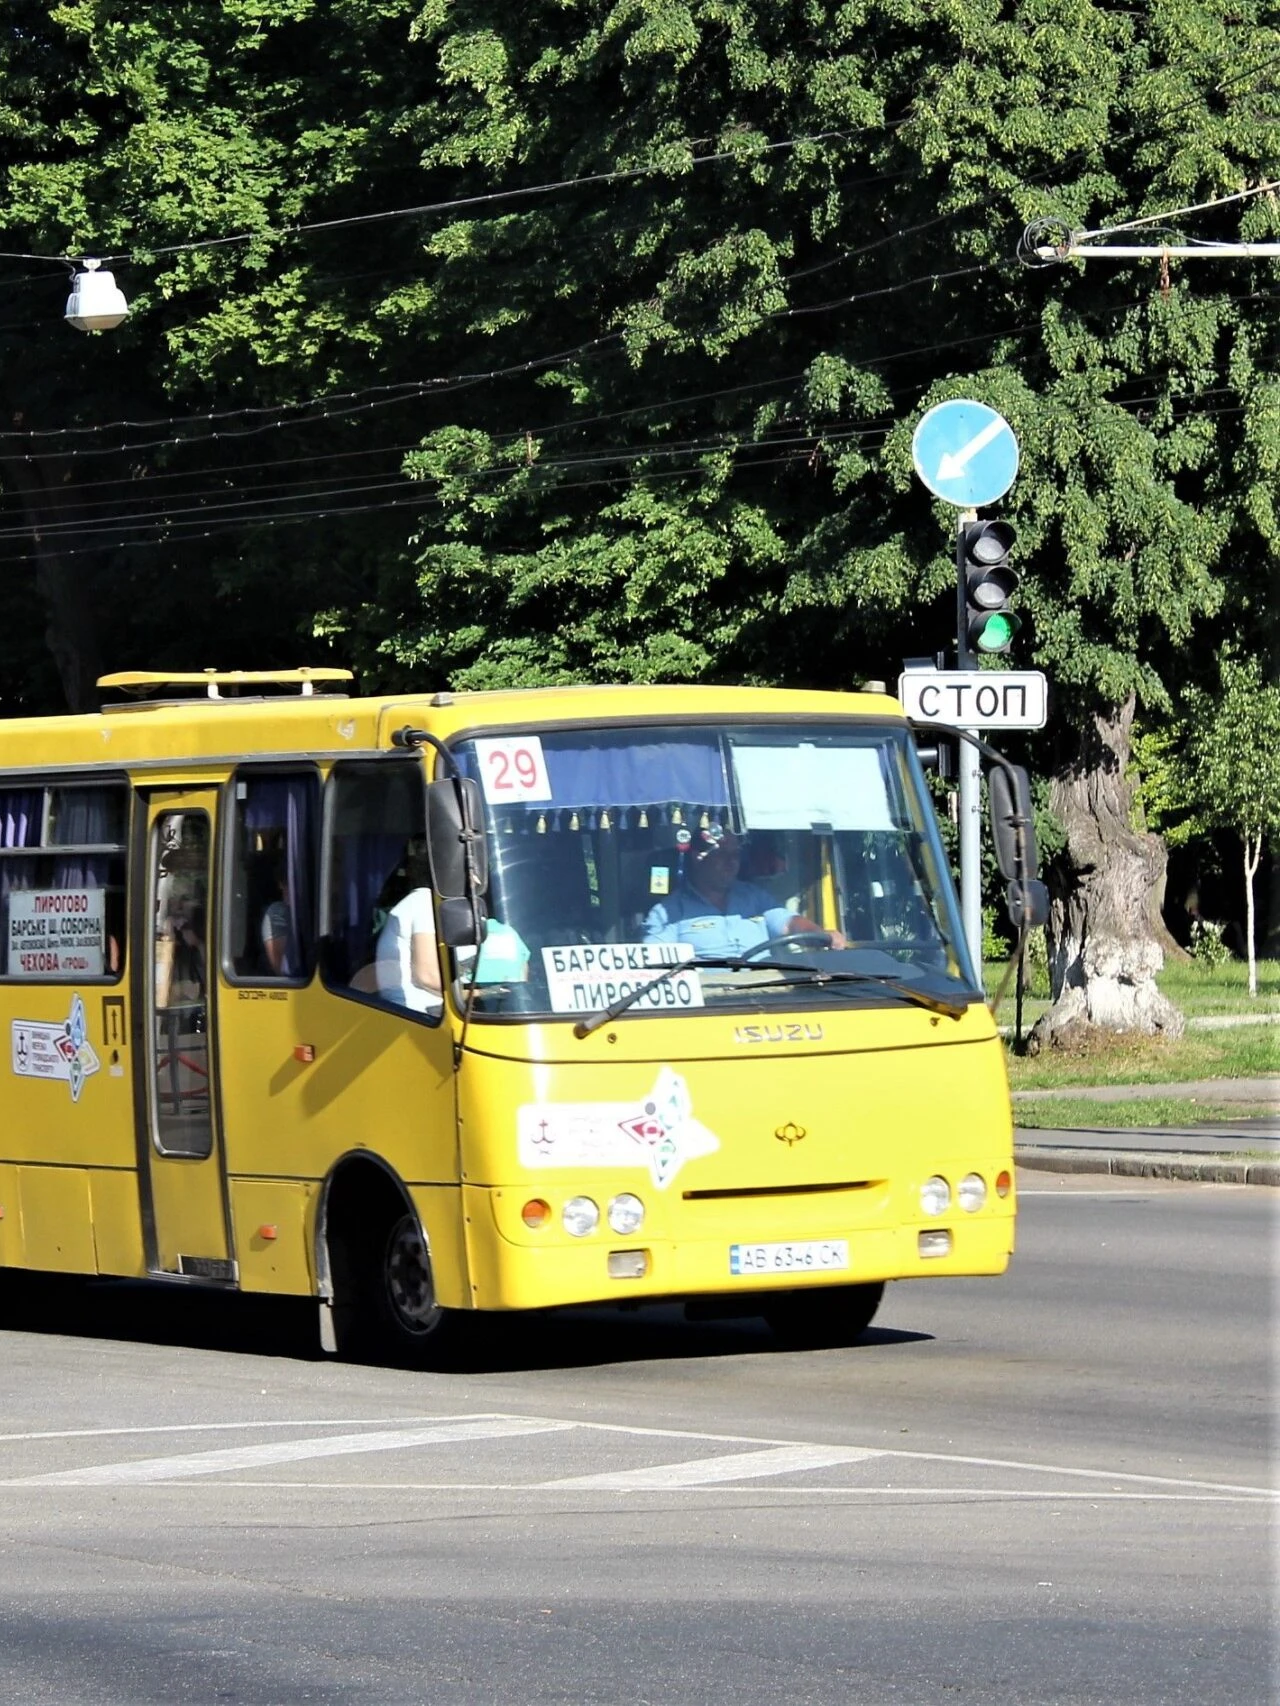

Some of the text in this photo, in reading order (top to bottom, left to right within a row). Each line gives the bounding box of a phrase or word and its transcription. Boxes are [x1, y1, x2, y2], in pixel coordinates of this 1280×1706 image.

[918, 684, 1026, 717] СТОП
[488, 749, 537, 789] 29
[11, 918, 46, 936] БАРСЬКЕ
[20, 952, 59, 971] ЧЕХОВА
[552, 946, 651, 973] БАРСЬКЕ
[734, 1023, 824, 1043] ISUZU
[743, 1247, 767, 1269] AB
